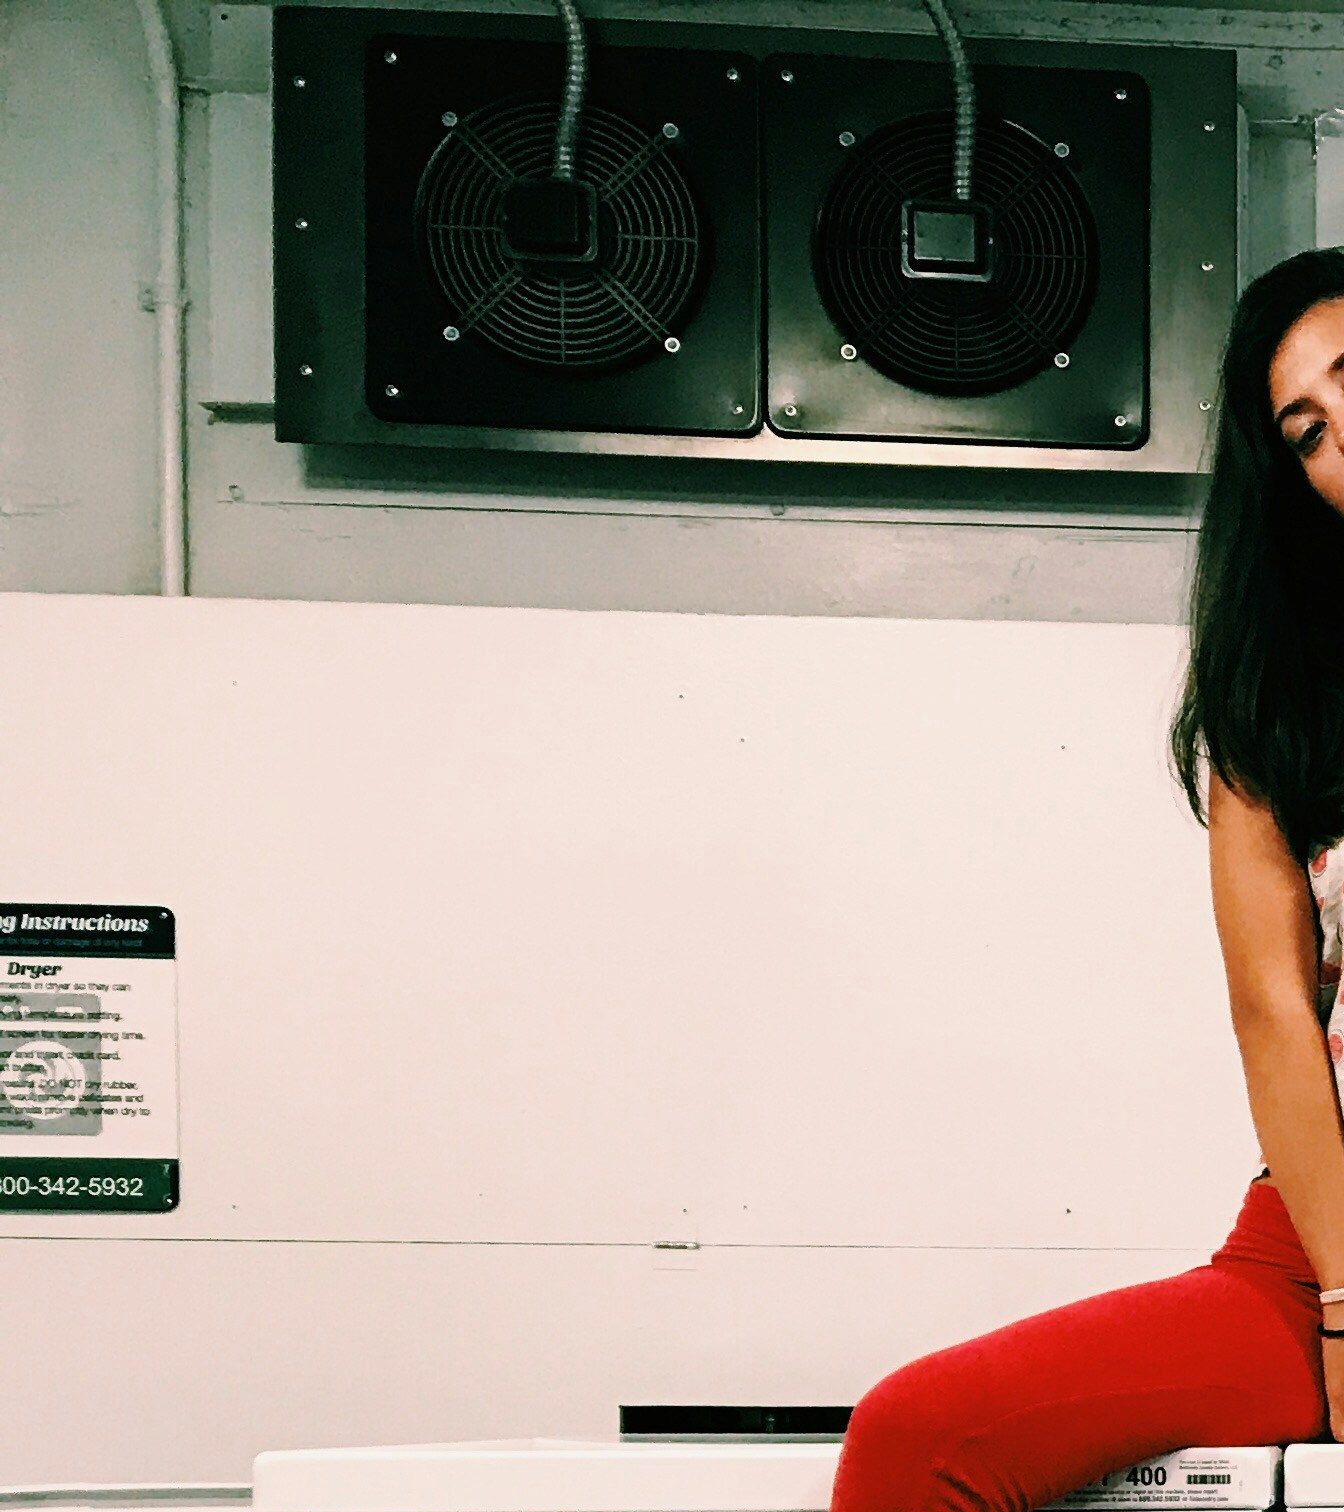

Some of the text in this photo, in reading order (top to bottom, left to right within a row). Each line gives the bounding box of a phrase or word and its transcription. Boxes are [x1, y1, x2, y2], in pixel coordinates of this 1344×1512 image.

[21, 914, 149, 933] Instructions
[7, 962, 62, 978] Dryer
[0, 1176, 143, 1196] 00-342-5932
[1126, 1467, 1167, 1486] 400
